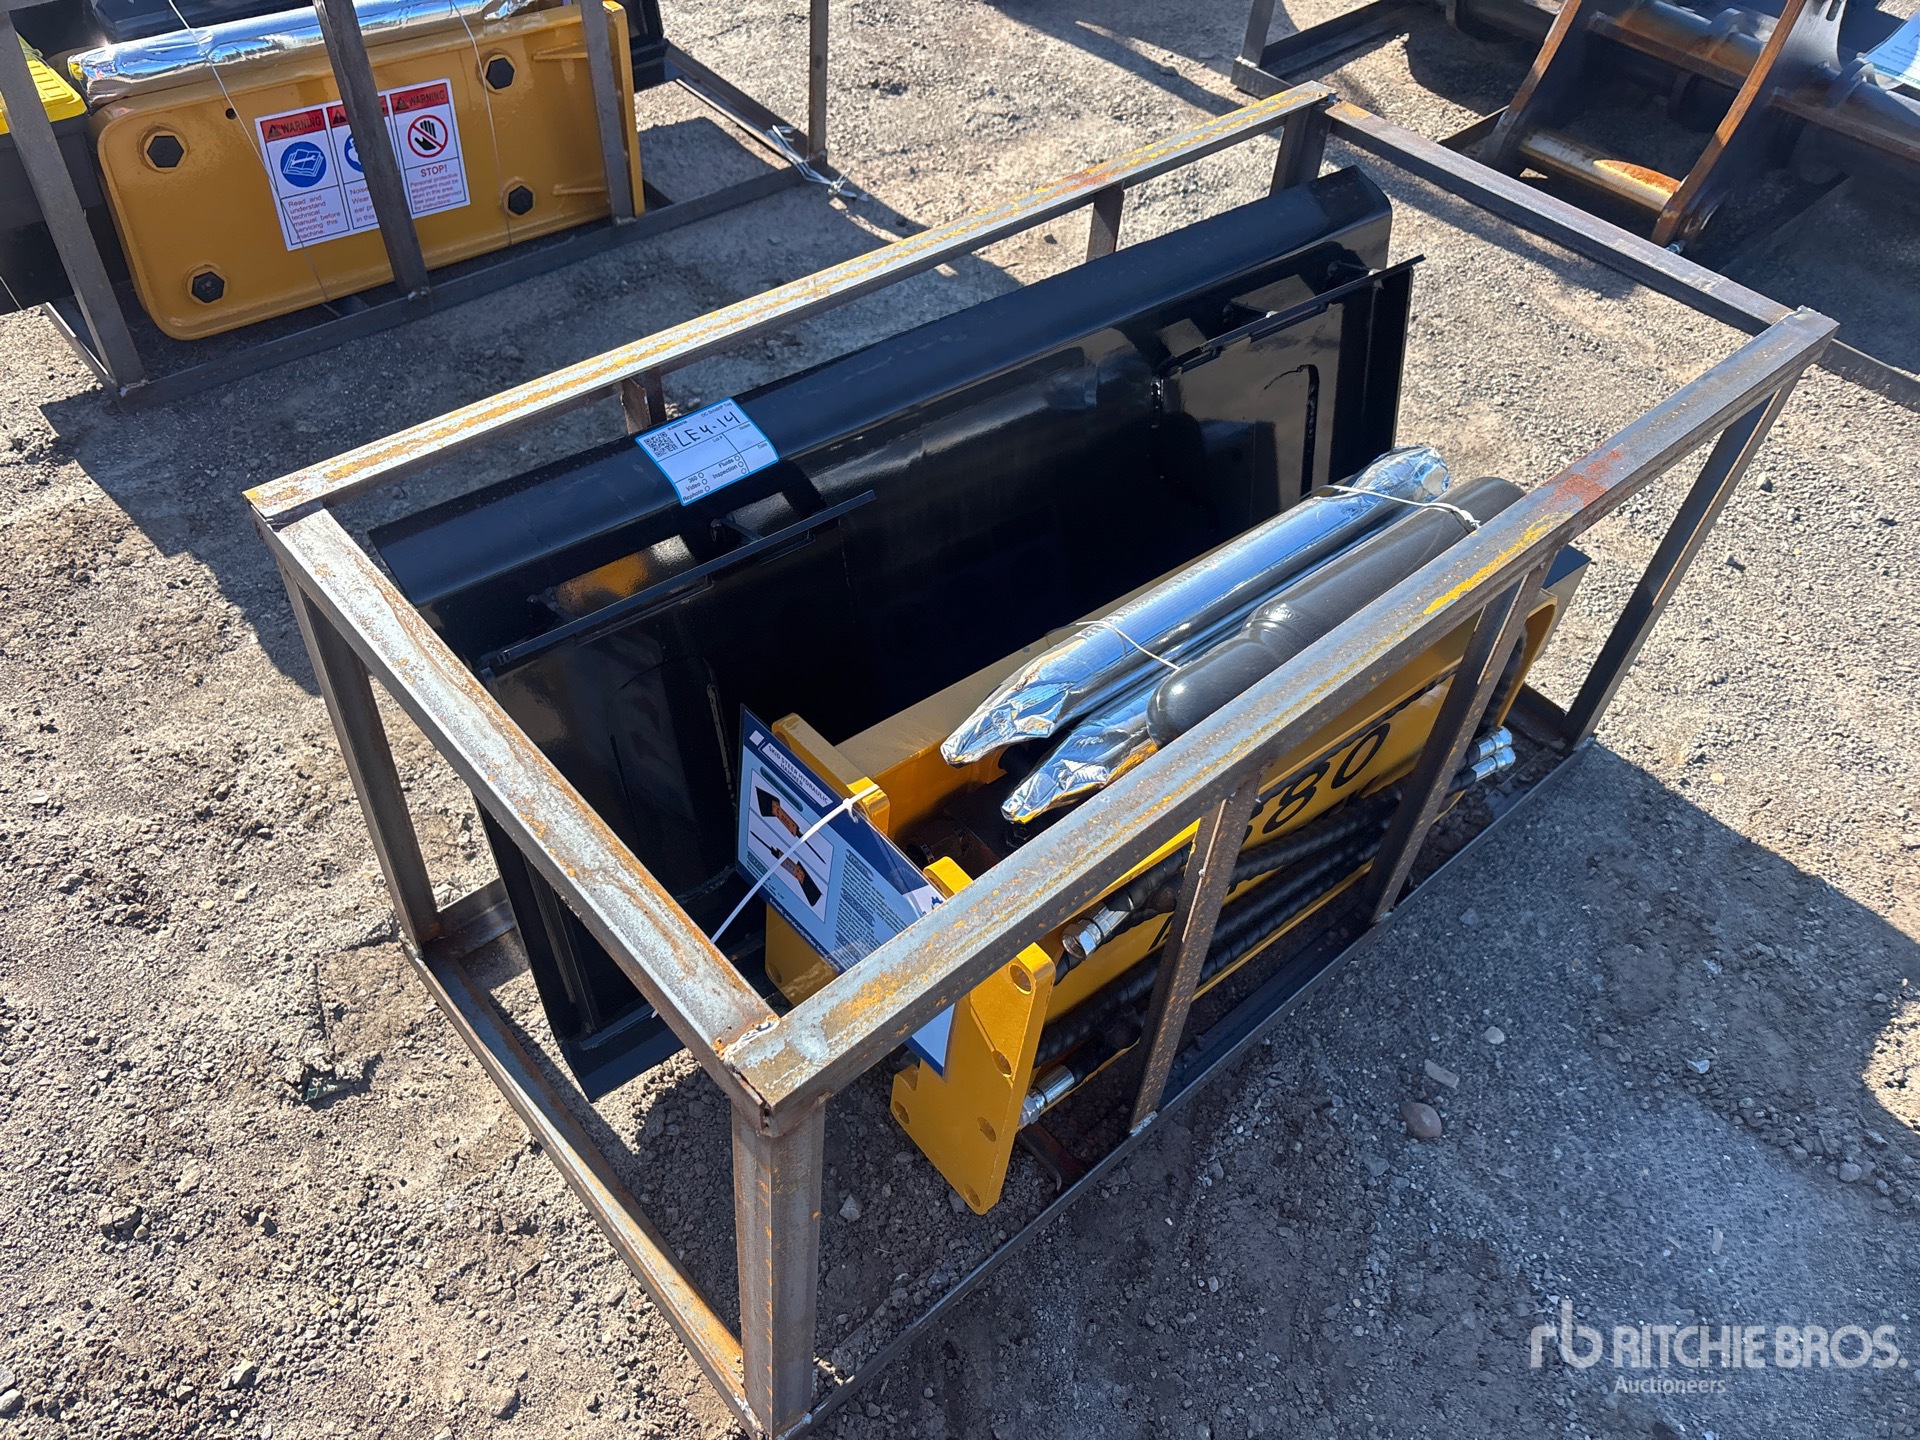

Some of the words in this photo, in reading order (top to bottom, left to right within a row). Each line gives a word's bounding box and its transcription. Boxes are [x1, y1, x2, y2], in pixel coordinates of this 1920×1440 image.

[409, 90, 446, 106] WARNING
[281, 116, 322, 133] WARNING
[420, 164, 447, 177] STOP!
[287, 198, 306, 208] Read
[309, 195, 322, 203] and
[351, 196, 369, 204] Wear
[290, 201, 326, 214] understand
[291, 209, 320, 220] technical
[293, 217, 318, 227] manual
[320, 211, 341, 220] before
[363, 213, 376, 221] this
[719, 458, 734, 468] Fluids
[712, 464, 738, 479] Inspection
[688, 475, 698, 484] 360
[686, 482, 701, 492] Video
[768, 745, 781, 760] SKID
[781, 756, 799, 776] STEER
[798, 773, 829, 804] HYDRAULIC
[780, 763, 804, 787] HAMMER
[1241, 723, 1391, 846] 80
